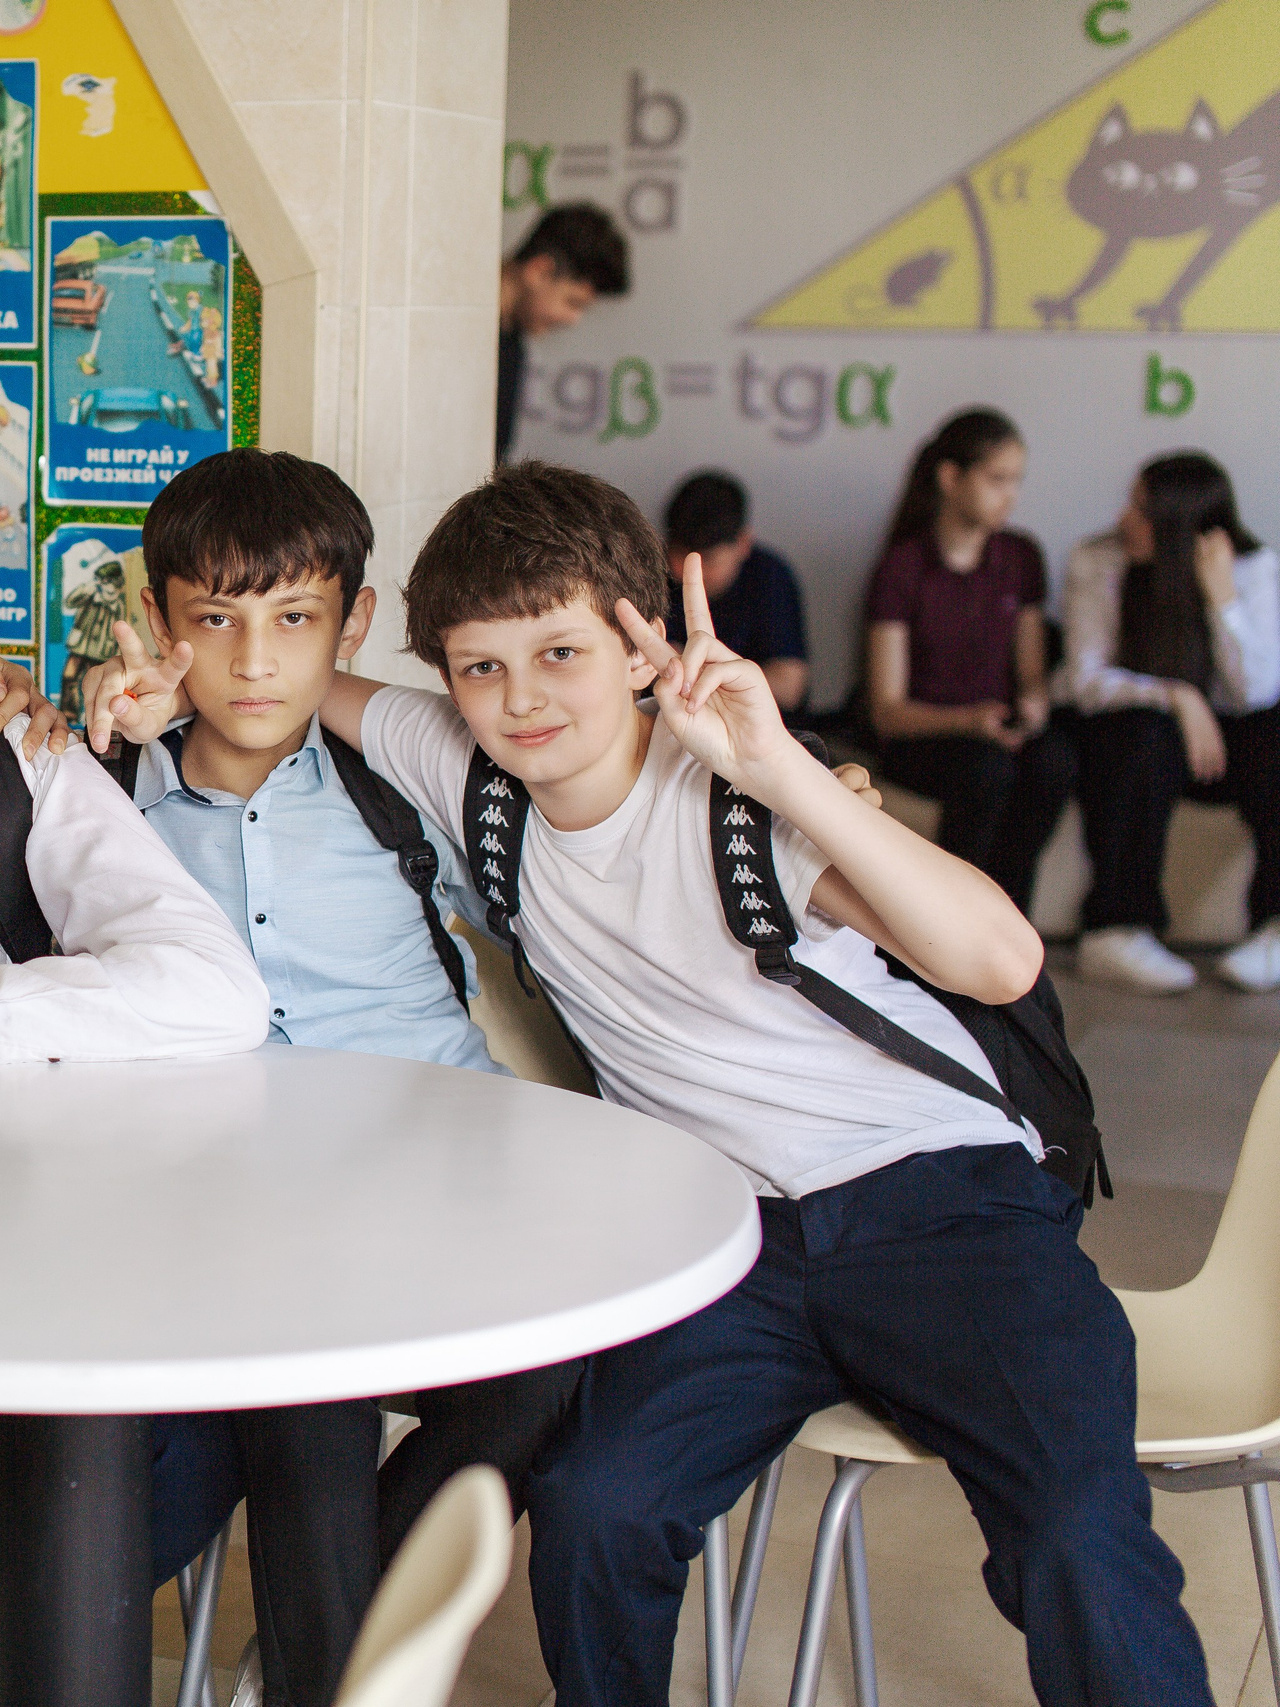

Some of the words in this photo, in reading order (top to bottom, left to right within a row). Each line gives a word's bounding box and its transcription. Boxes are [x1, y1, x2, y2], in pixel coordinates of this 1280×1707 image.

[86, 448, 110, 463] НЕ
[112, 445, 174, 464] ИГРАЙ
[177, 450, 190, 465] У
[55, 464, 156, 484] ПРОЕЗЖЕЙ
